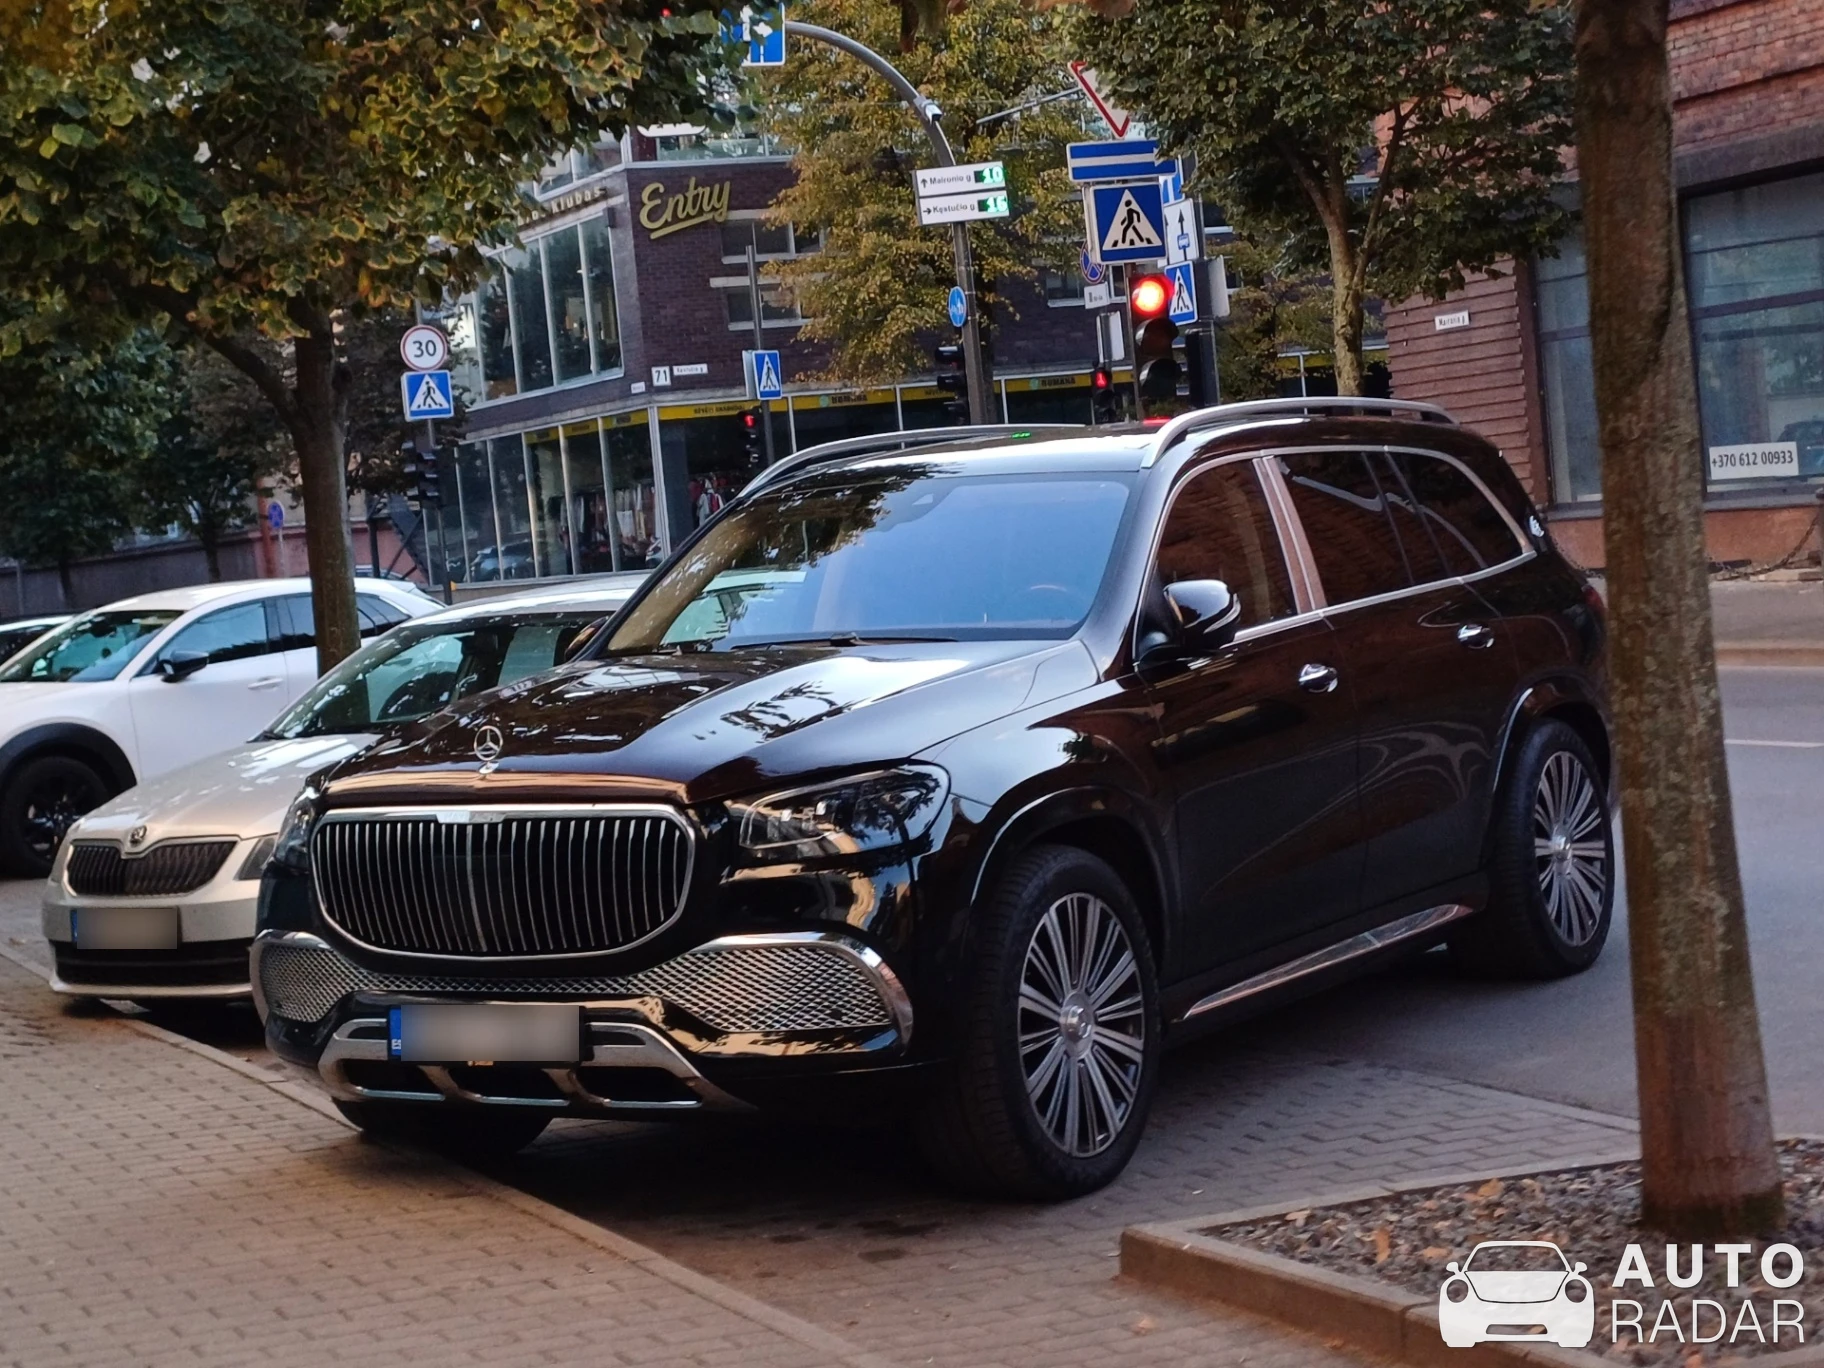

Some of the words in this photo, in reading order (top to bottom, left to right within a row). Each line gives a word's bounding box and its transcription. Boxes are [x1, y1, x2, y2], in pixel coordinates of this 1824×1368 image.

[929, 176, 964, 185] Maironio
[982, 167, 1004, 184] 10
[551, 187, 602, 214] klubas
[639, 176, 731, 231] Entry
[412, 339, 437, 358] 30
[655, 369, 668, 383] 71
[1711, 454, 1737, 468] +370
[1738, 452, 1758, 467] 612
[1760, 450, 1794, 465] 00933
